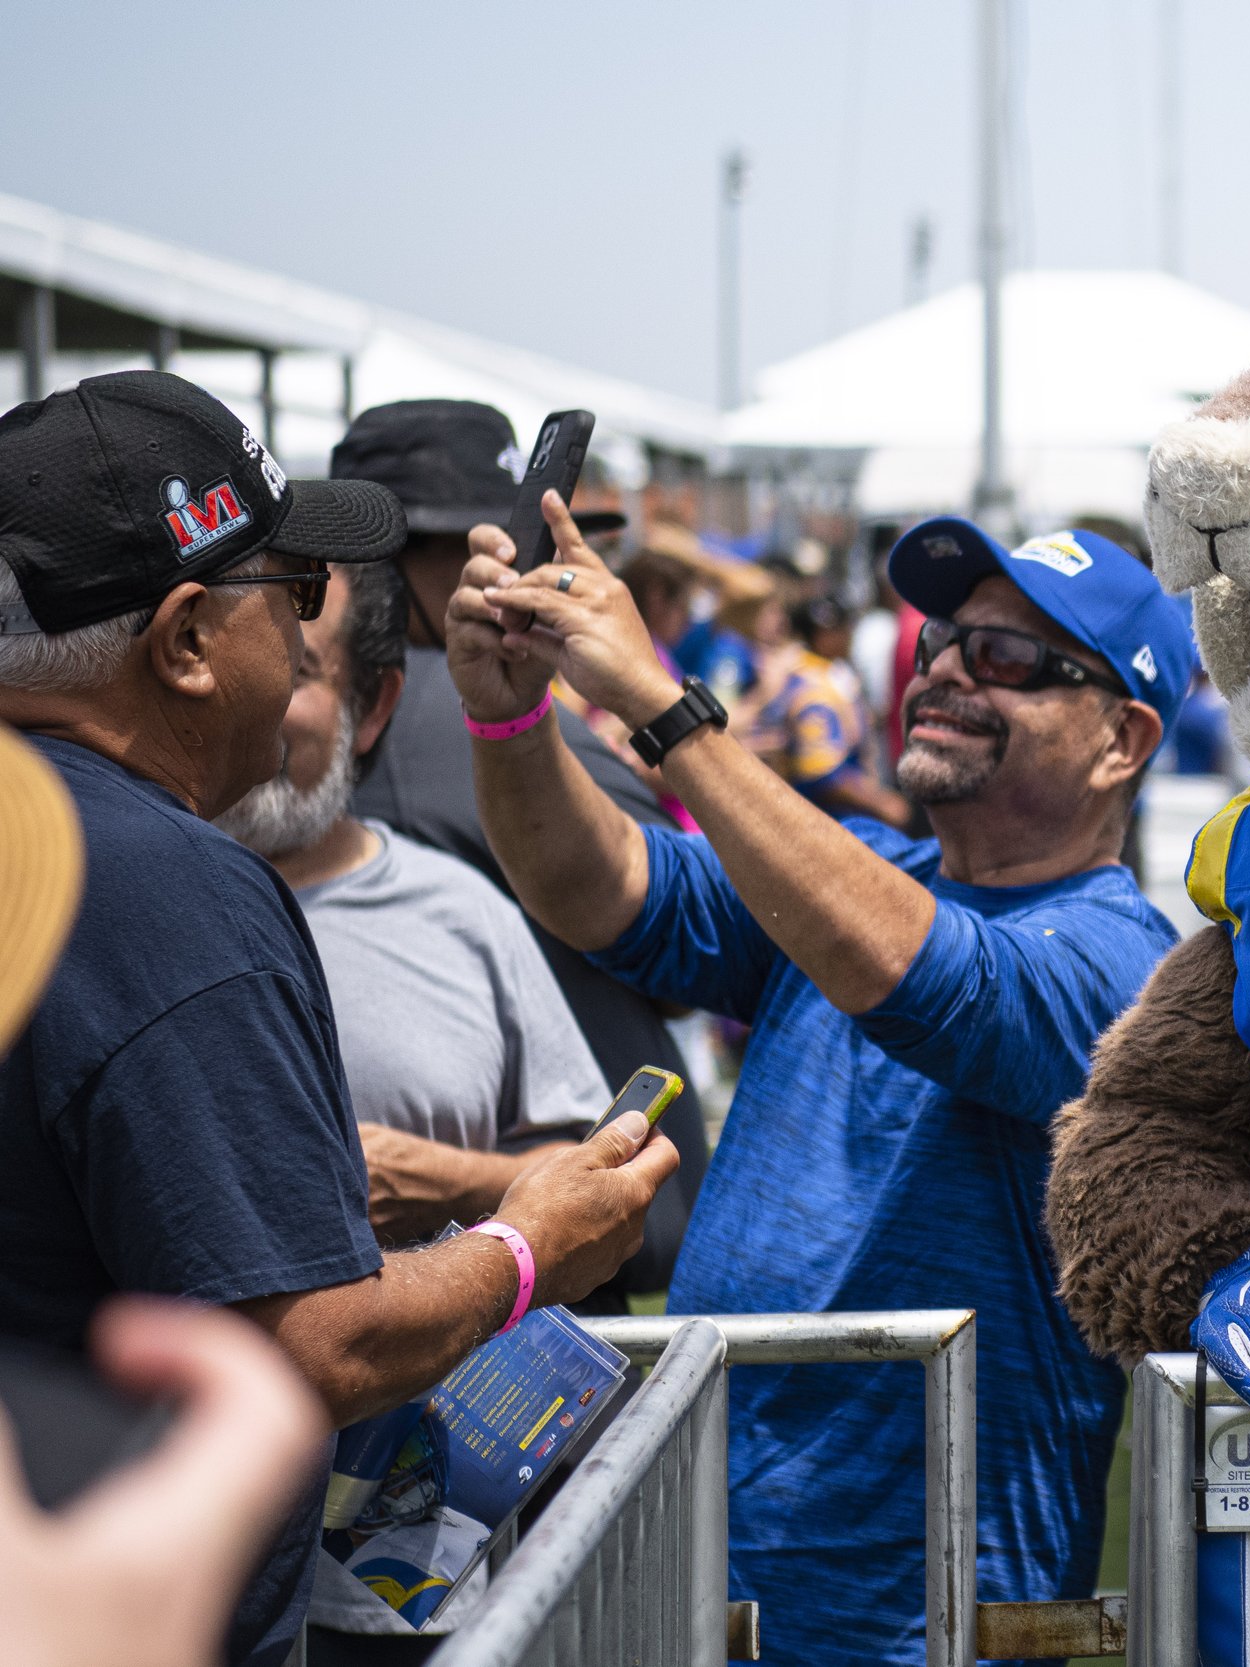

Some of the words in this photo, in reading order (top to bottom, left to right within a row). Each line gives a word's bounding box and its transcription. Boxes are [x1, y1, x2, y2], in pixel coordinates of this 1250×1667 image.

[165, 482, 242, 548] LVI
[188, 533, 214, 551] SUPER
[216, 519, 240, 535] BOWL
[462, 1367, 484, 1391] Francisco
[480, 1369, 501, 1392] Cardinals
[464, 1432, 476, 1444] DEC
[481, 1405, 498, 1423] Seattle
[469, 1436, 481, 1449] DEC
[487, 1417, 497, 1428] Las
[494, 1403, 509, 1419] Vegas
[506, 1386, 523, 1405] Raiders
[480, 1445, 492, 1458] DEC
[498, 1418, 514, 1437] Denver
[511, 1400, 530, 1421] Broncos
[1228, 1471, 1250, 1480] SITE
